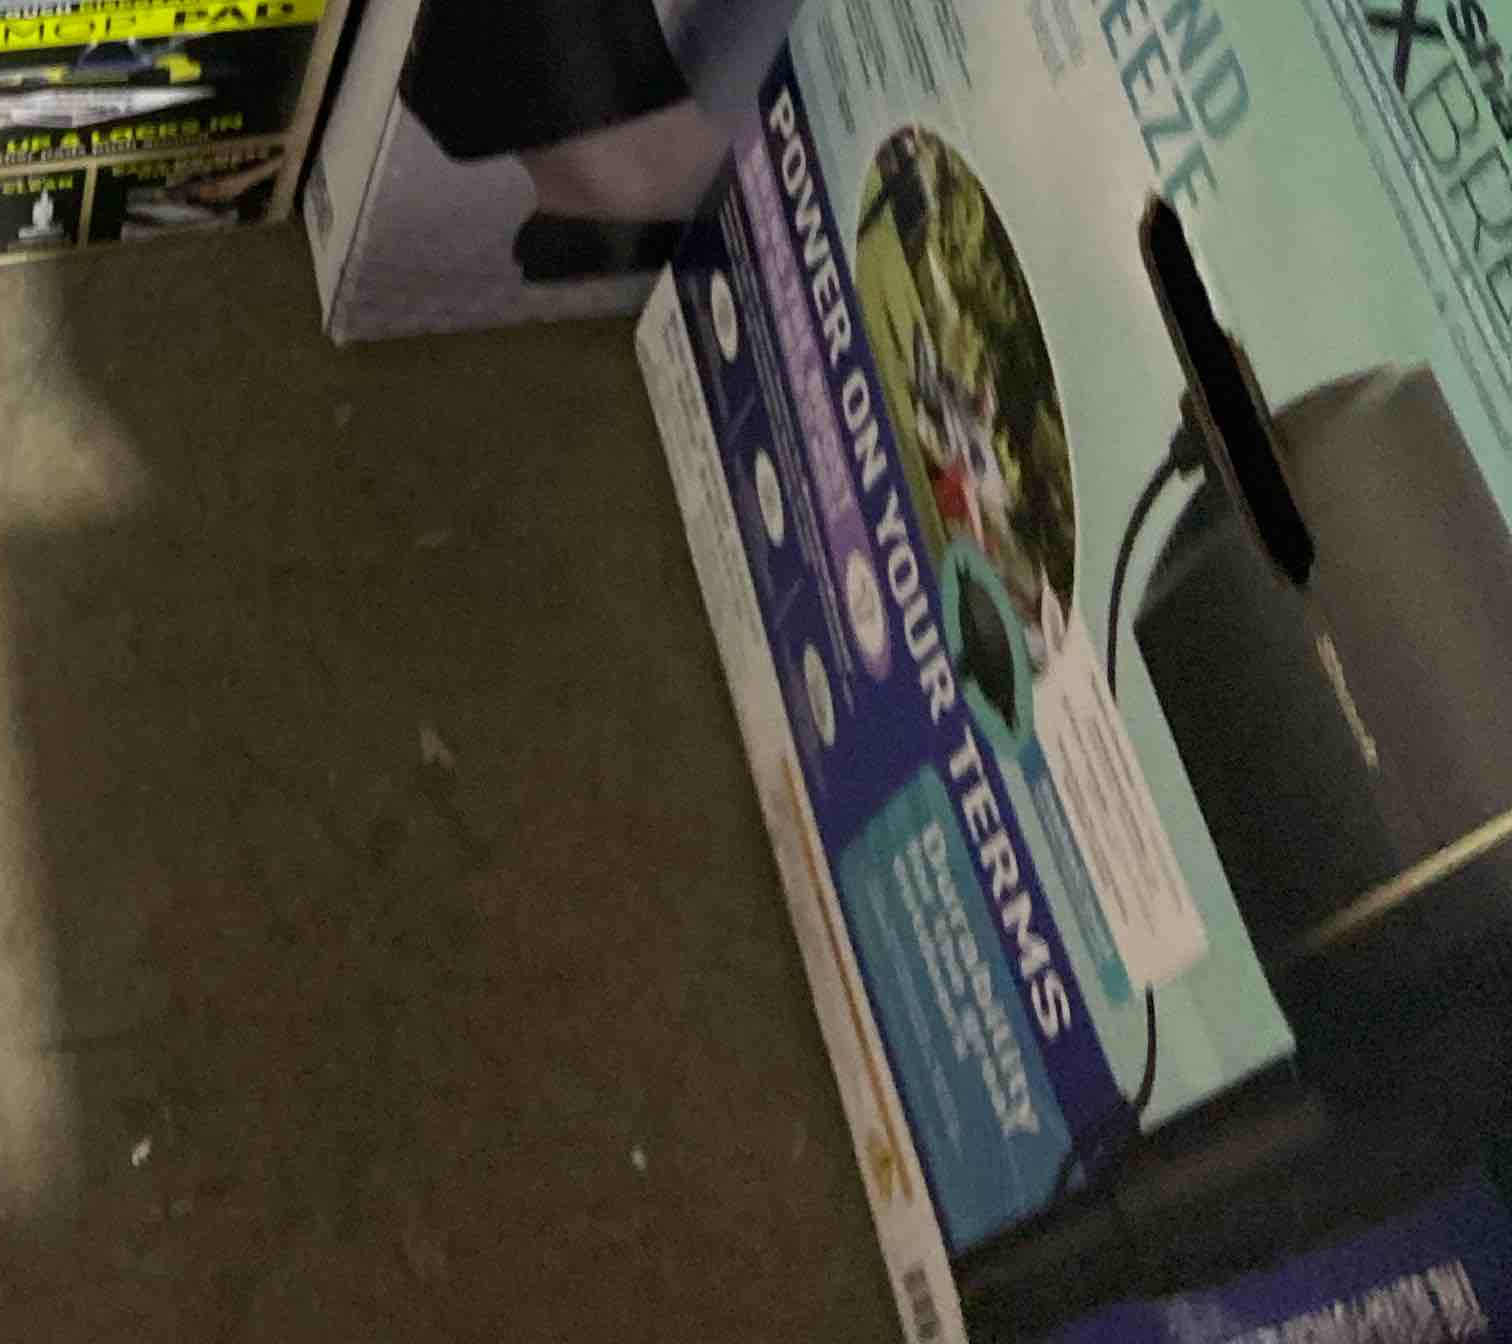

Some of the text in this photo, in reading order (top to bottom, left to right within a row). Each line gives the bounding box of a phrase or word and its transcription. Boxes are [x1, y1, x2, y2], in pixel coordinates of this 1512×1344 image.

[768, 85, 852, 366] POWER
[839, 372, 890, 493] ON
[874, 489, 957, 726] YOUR
[949, 726, 1072, 1043] TERMS
